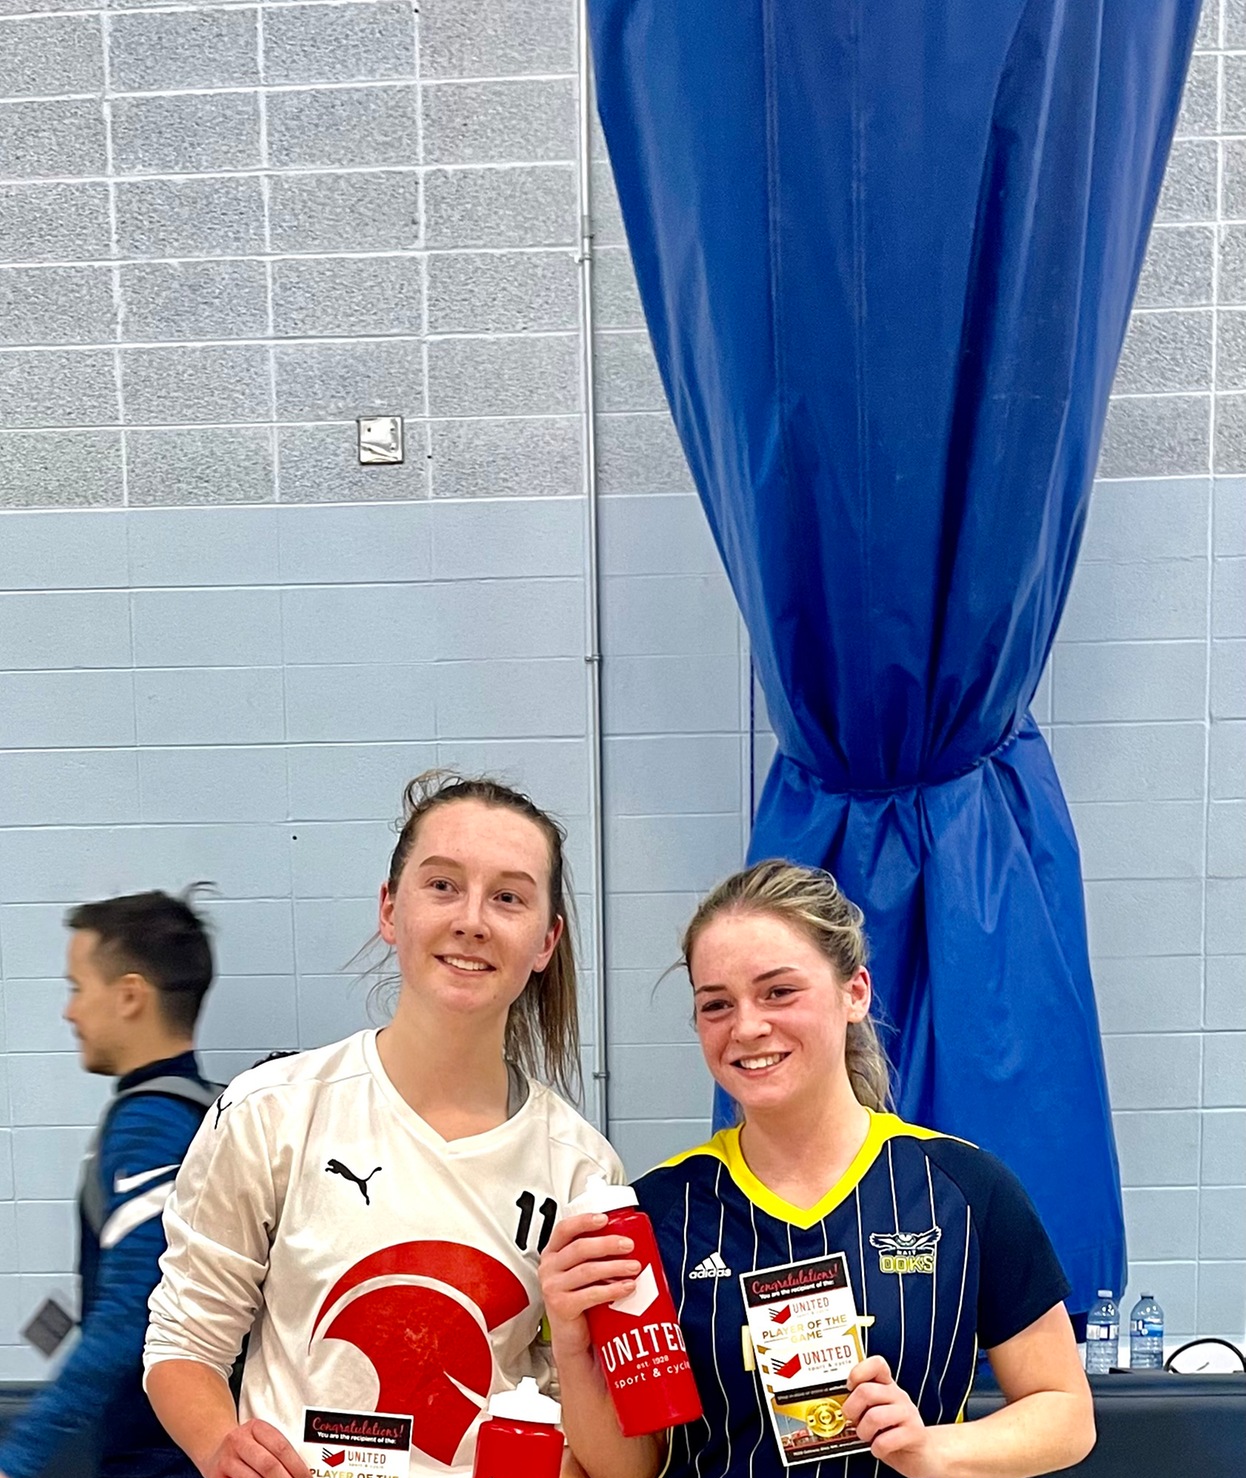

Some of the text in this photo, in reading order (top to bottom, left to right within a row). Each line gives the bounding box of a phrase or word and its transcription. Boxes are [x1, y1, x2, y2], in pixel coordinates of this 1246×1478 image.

[515, 1191, 557, 1255] 11
[689, 1267, 732, 1279] adidas
[880, 1254, 935, 1273] OOKS
[752, 1263, 839, 1294] Congratulations!
[762, 1314, 847, 1339] PLAYER OF THE
[790, 1329, 823, 1343] GAME
[614, 1372, 647, 1389] sport
[652, 1367, 661, 1378] &
[312, 1416, 405, 1438] Congratulations!
[317, 1431, 329, 1439] You
[350, 1435, 376, 1443] recipient
